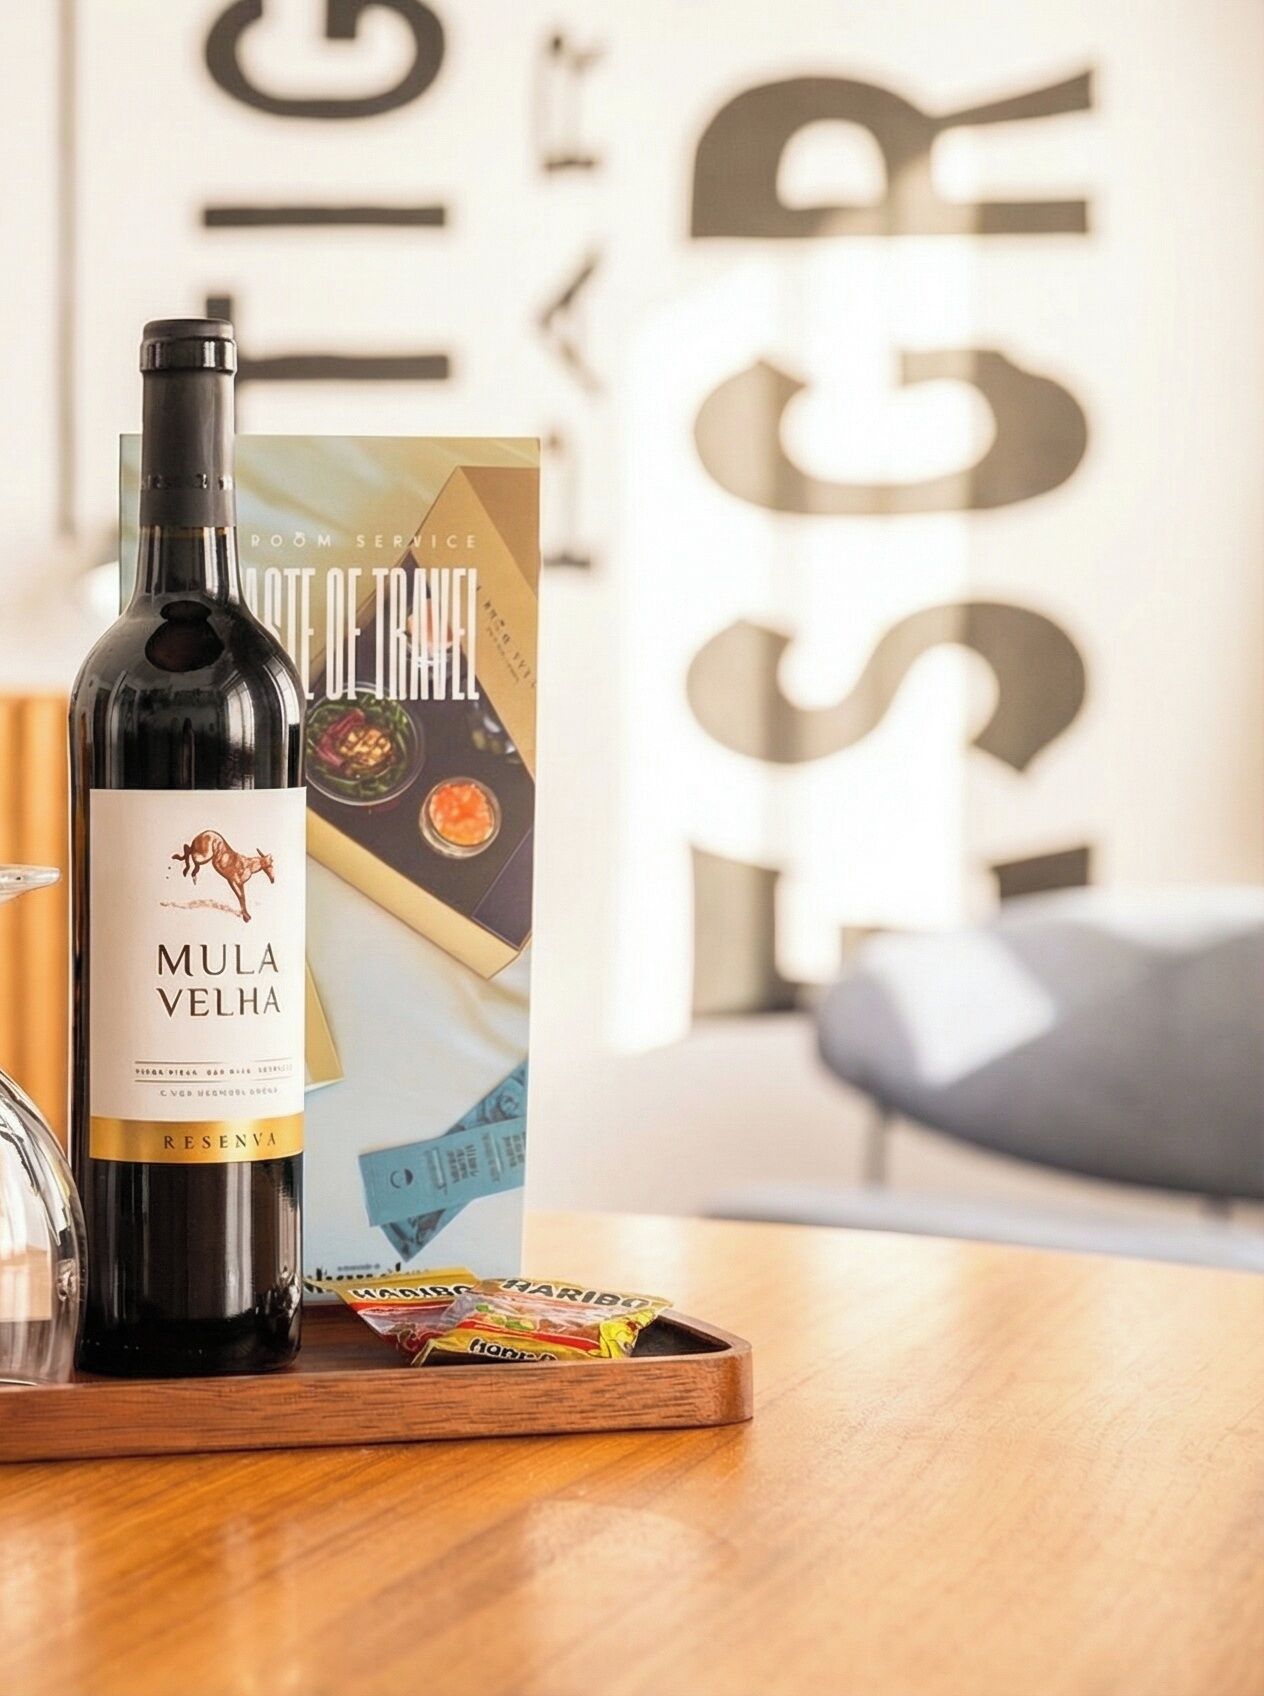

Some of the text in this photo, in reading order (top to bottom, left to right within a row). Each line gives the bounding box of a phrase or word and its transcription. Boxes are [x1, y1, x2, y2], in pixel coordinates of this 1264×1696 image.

[356, 534, 476, 548] SERVICE
[326, 567, 362, 700] OF
[372, 567, 480, 700] TRAVEL
[157, 942, 279, 977] MULA
[156, 985, 281, 1018] VELHA
[502, 1279, 650, 1308] HARIBO
